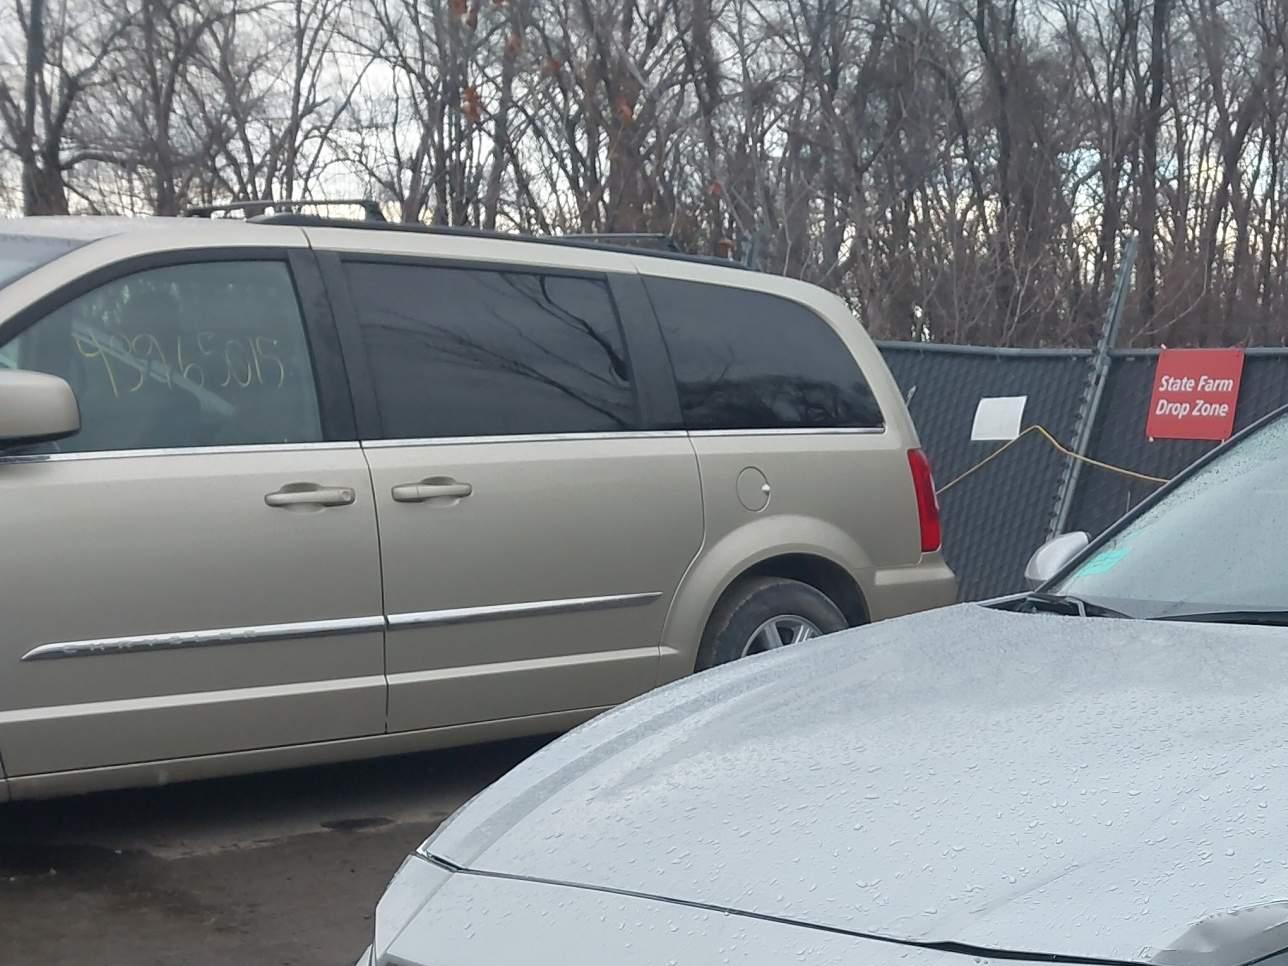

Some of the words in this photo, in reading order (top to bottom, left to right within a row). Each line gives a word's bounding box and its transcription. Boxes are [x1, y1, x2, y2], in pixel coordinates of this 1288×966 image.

[1159, 375, 1195, 392] State
[1197, 375, 1234, 392] Farm
[1155, 399, 1190, 419] Drop
[1192, 399, 1229, 417] Zone
